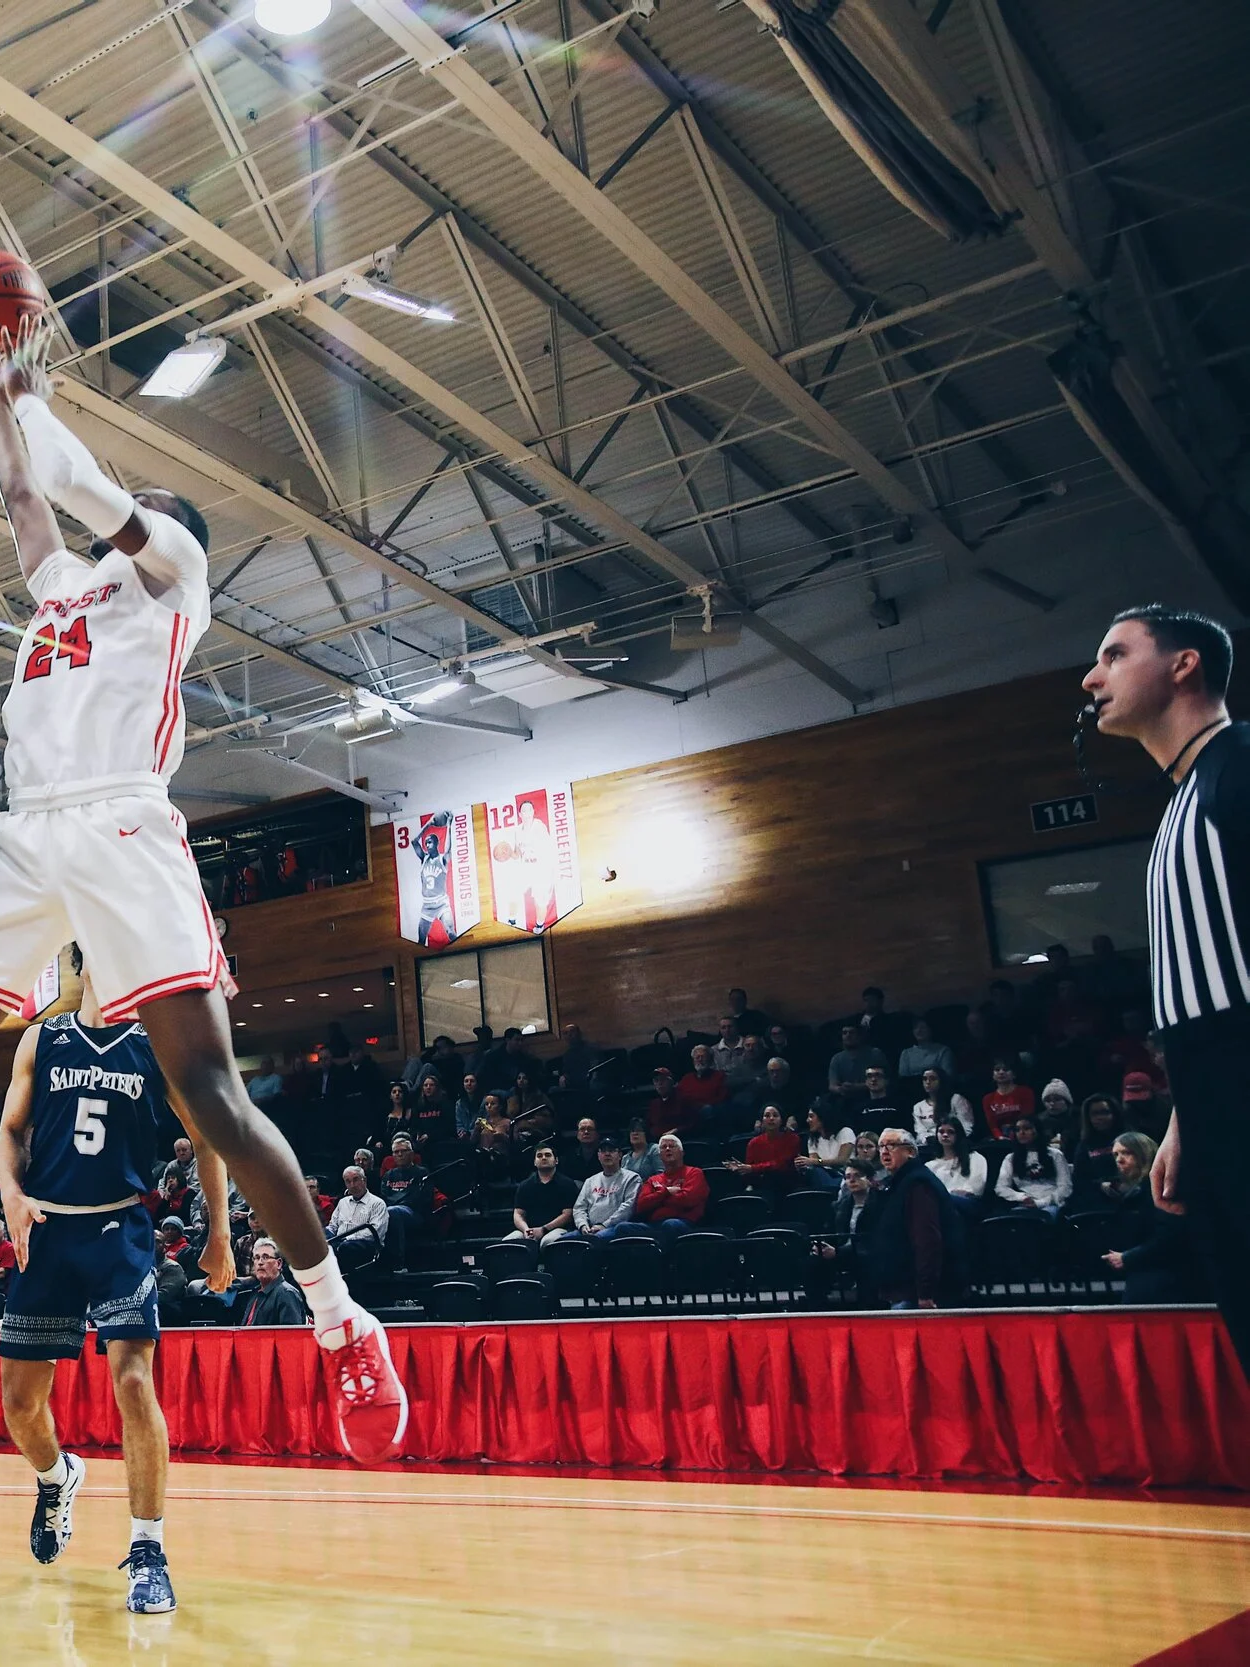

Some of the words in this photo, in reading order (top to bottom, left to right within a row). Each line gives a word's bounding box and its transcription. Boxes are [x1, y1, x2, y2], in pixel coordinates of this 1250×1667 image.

[23, 615, 92, 683] 24
[490, 804, 515, 831] 12
[552, 792, 570, 849] RACHELE
[1043, 800, 1087, 825] 114
[397, 826, 410, 850] 3
[454, 813, 470, 864] DRAFTON
[557, 852, 573, 880] FITZ
[426, 876, 435, 890] 3
[458, 866, 472, 900] DAVIS
[73, 1096, 109, 1156] 5
